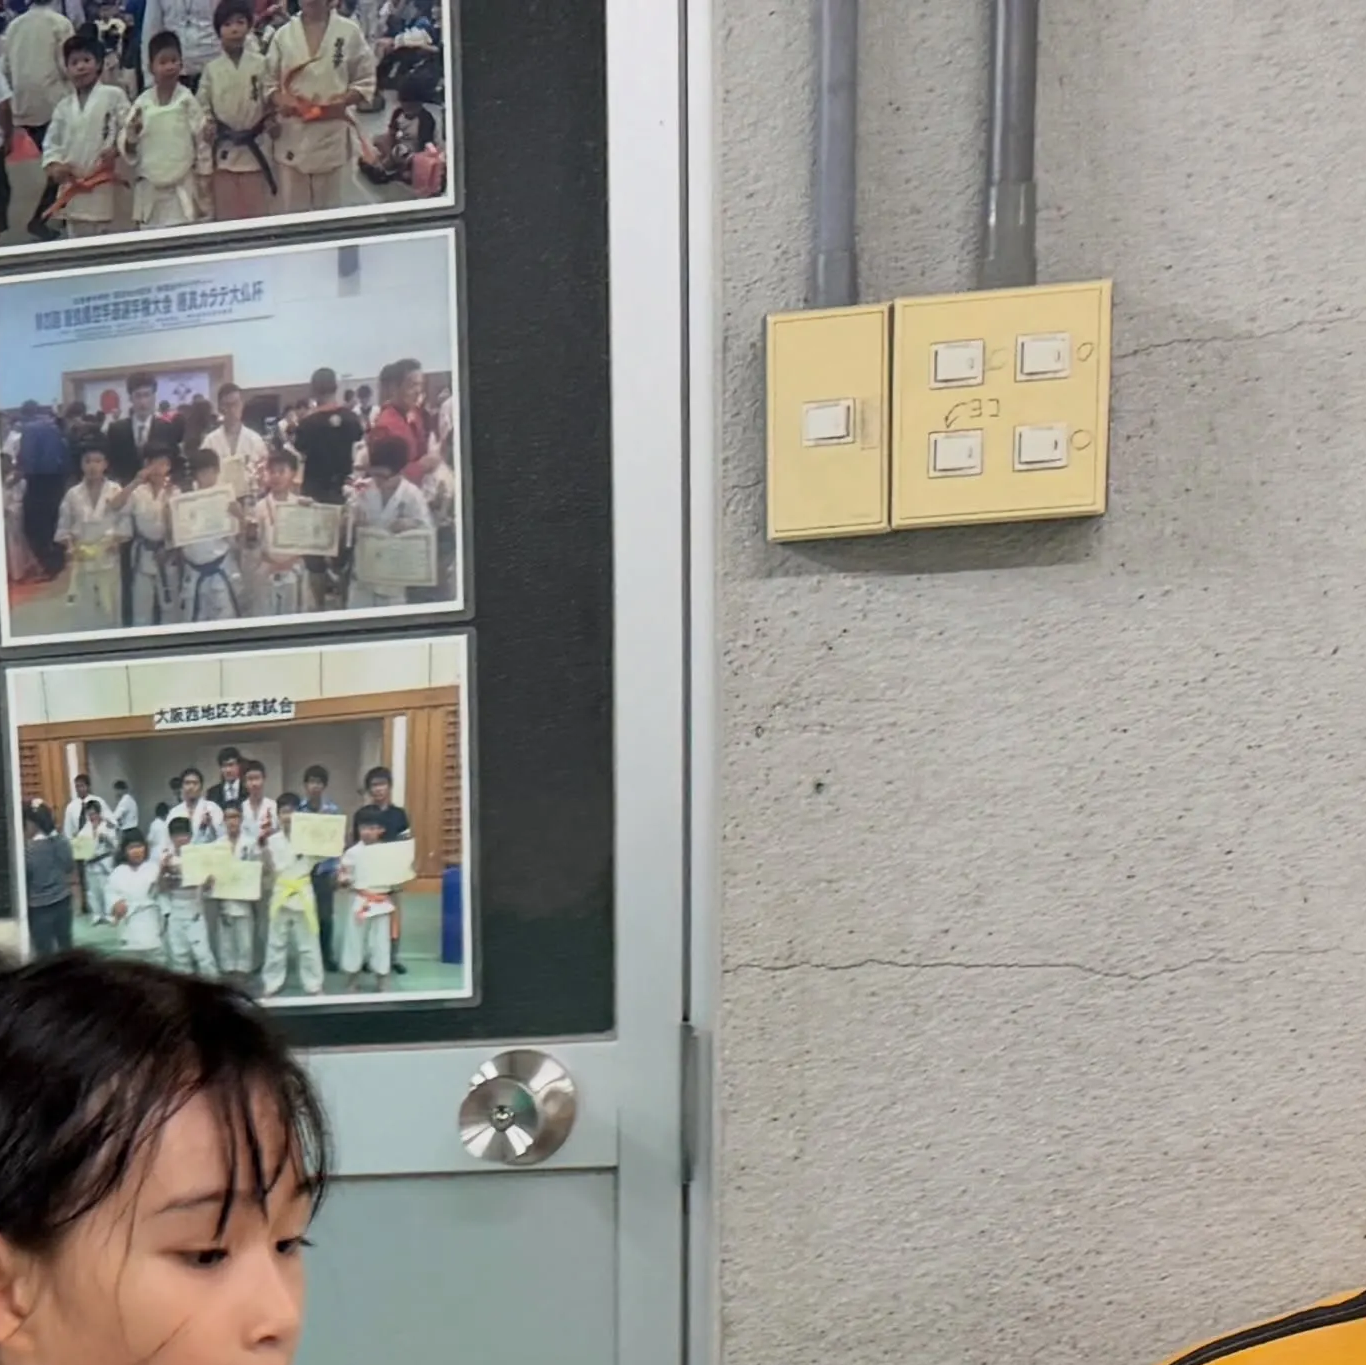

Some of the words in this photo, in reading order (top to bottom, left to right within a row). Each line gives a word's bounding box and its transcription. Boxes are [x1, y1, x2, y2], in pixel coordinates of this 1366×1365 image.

[155, 697, 293, 724] 大阪西地区交流試合
